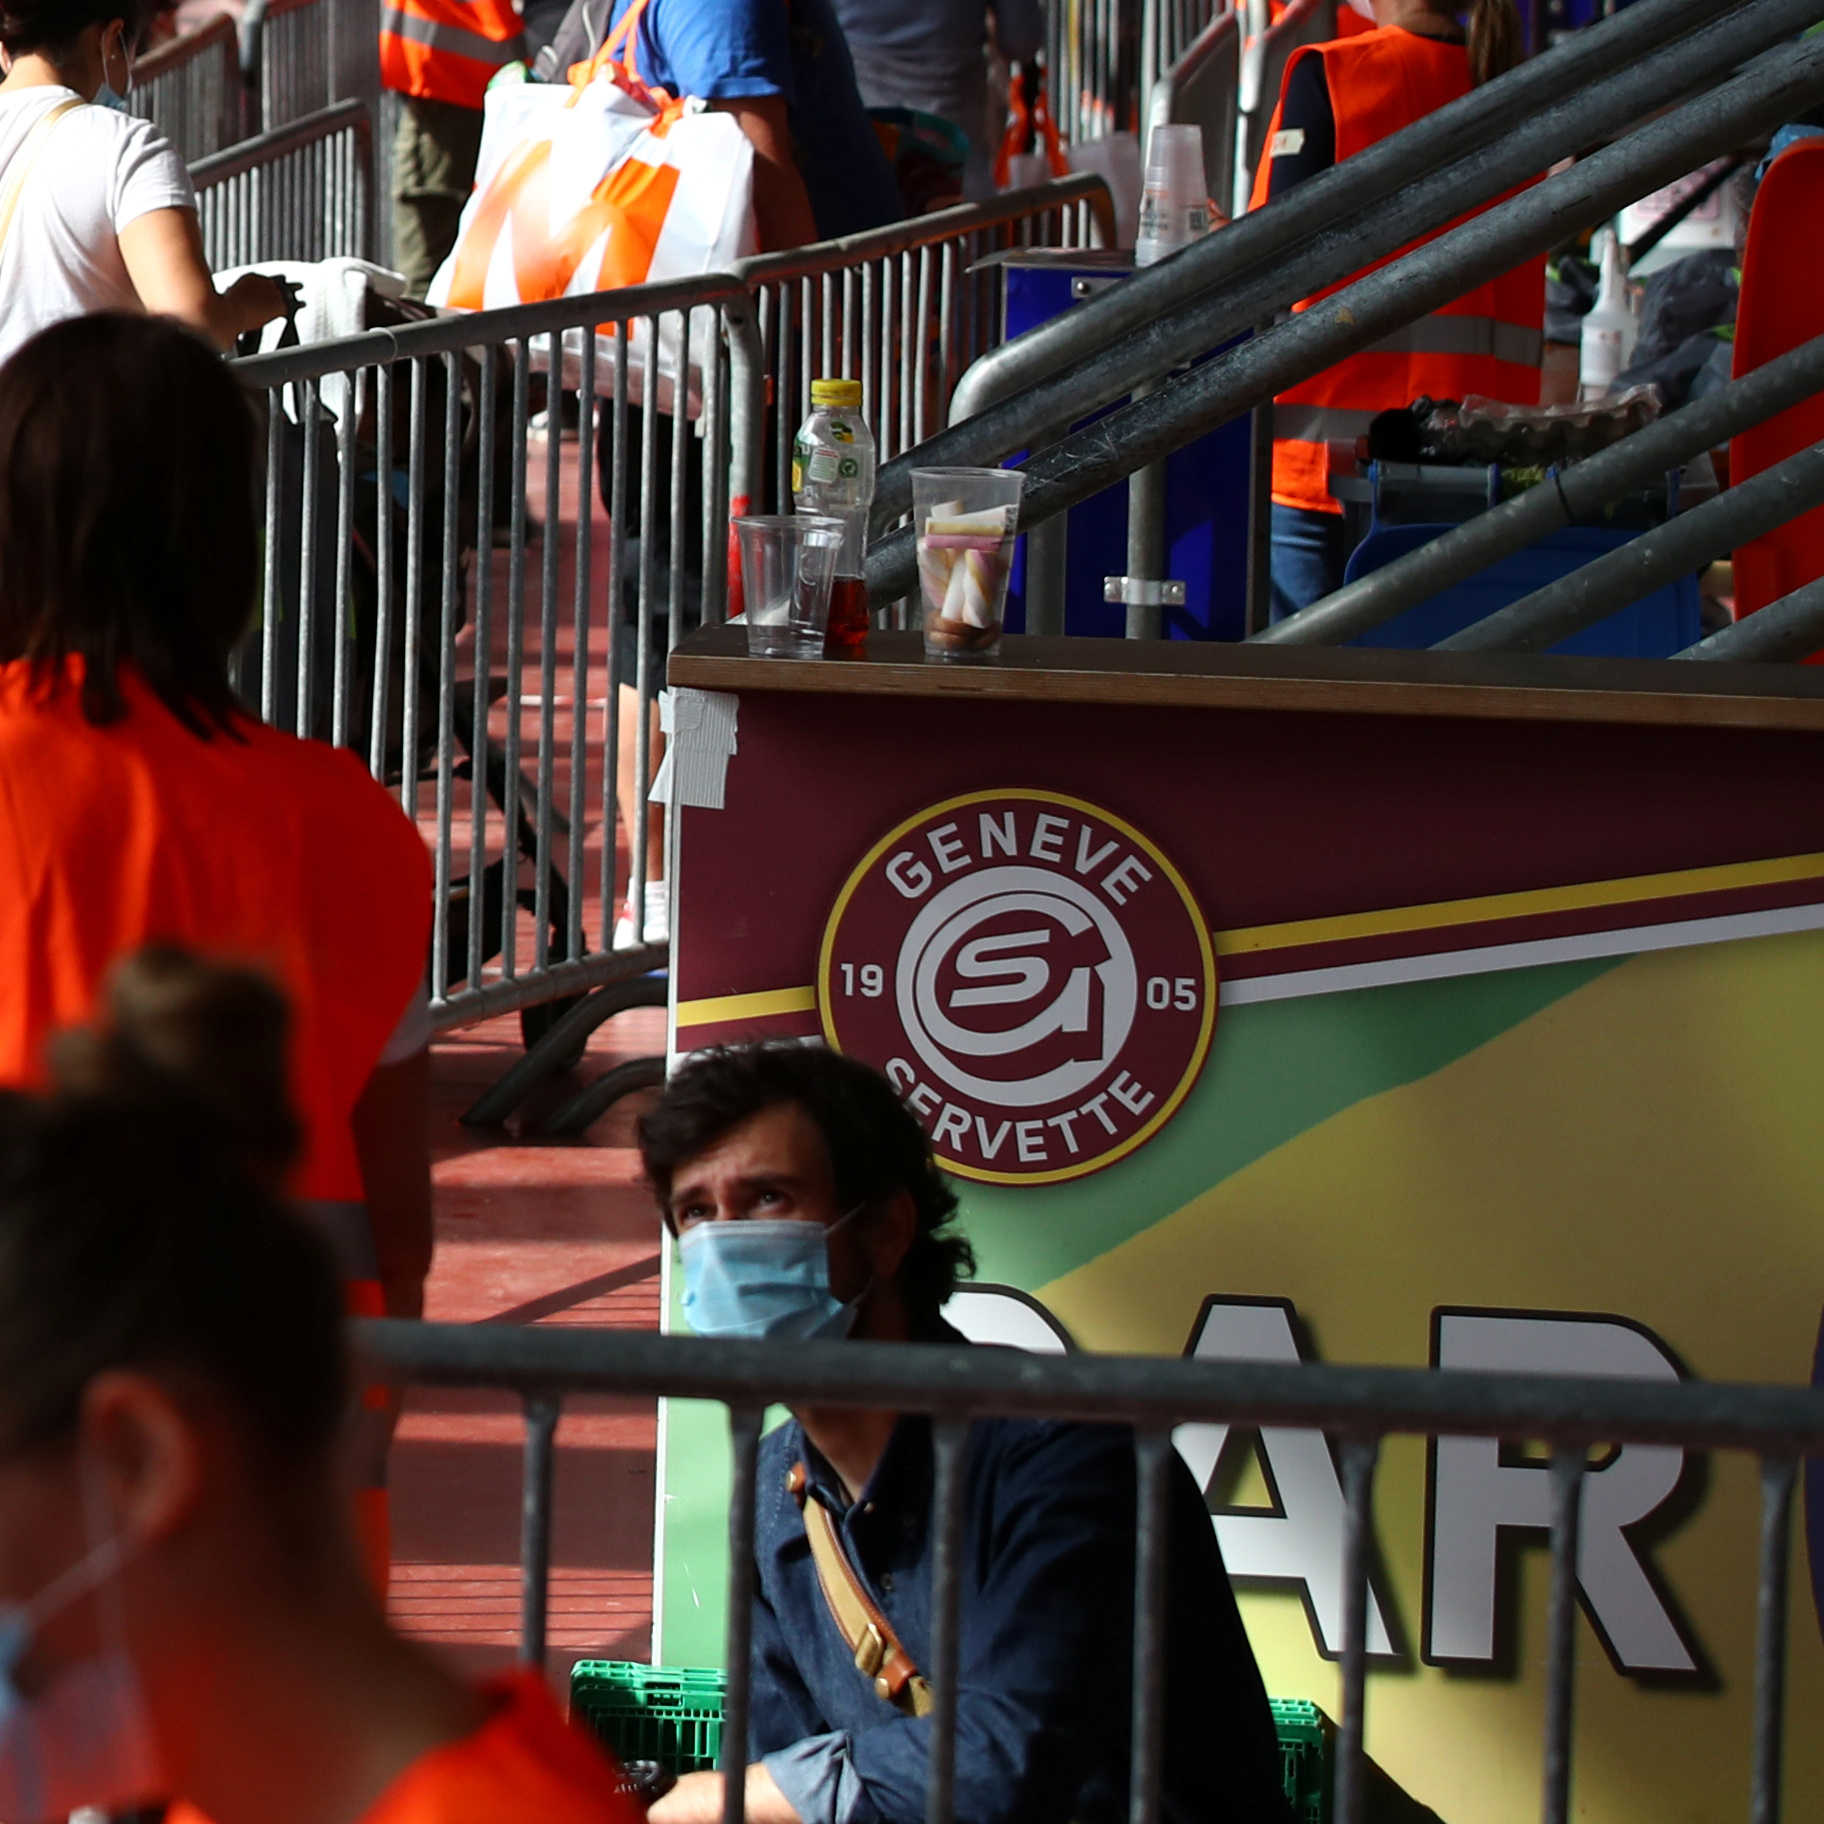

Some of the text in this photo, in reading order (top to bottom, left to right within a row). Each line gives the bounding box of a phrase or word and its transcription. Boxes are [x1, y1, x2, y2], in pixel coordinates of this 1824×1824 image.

[883, 811, 1154, 909] GENEVE
[838, 962, 1198, 1014] 19 05
